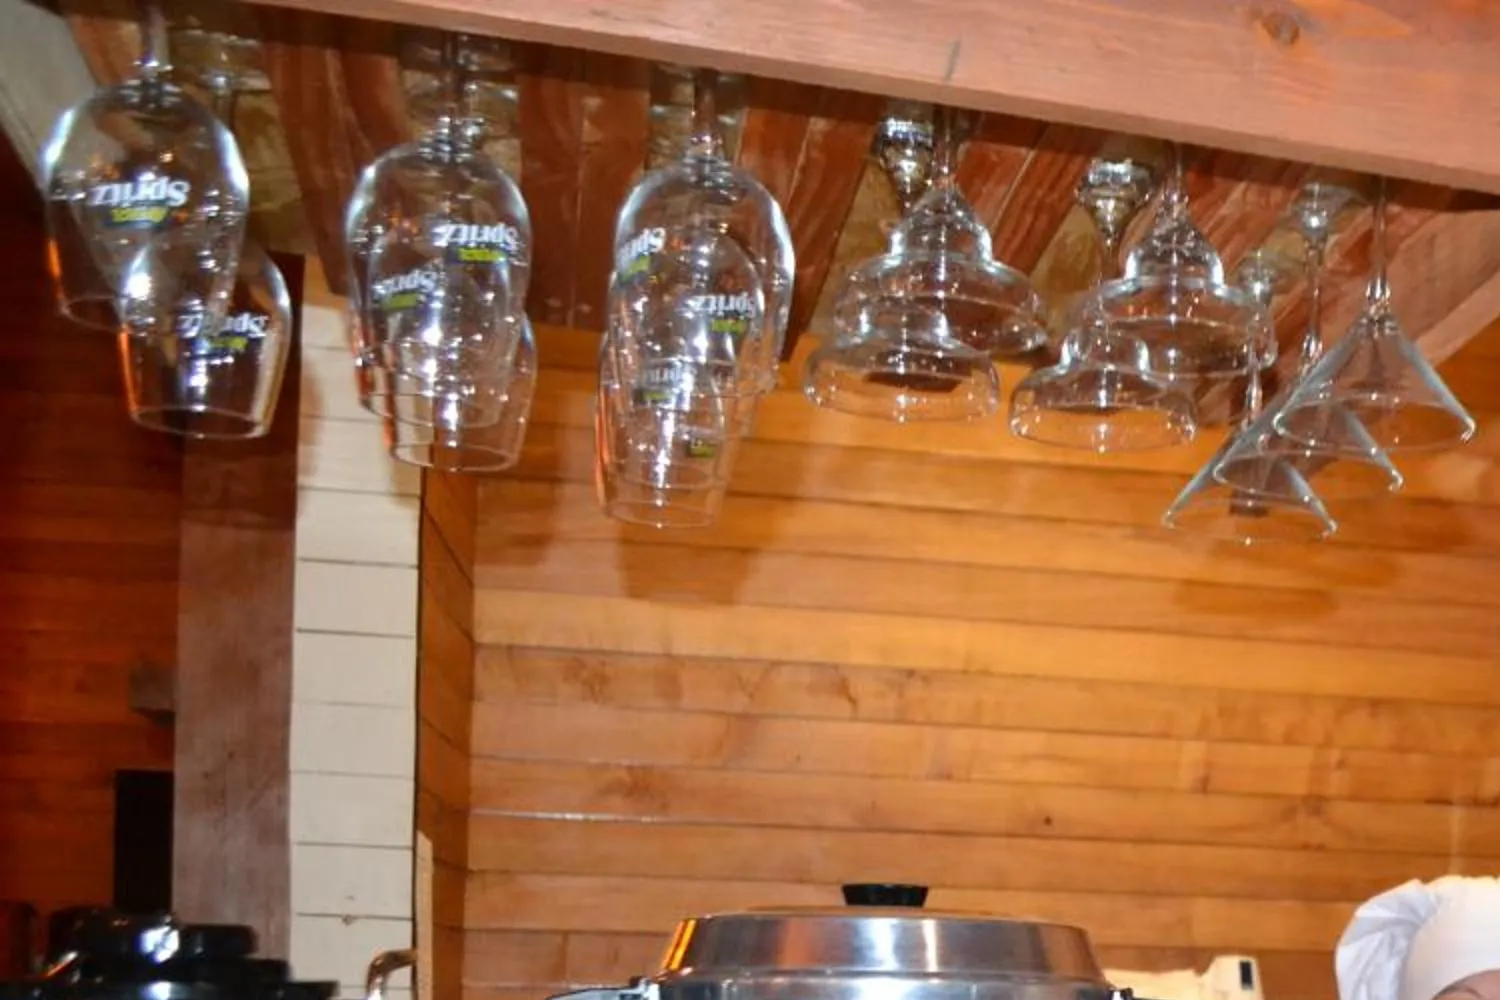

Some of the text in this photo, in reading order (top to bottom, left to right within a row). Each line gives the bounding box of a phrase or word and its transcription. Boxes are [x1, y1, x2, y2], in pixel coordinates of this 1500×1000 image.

[89, 178, 191, 209] Spritz
[431, 222, 519, 250] Spritz
[175, 311, 270, 340] Sprtz
